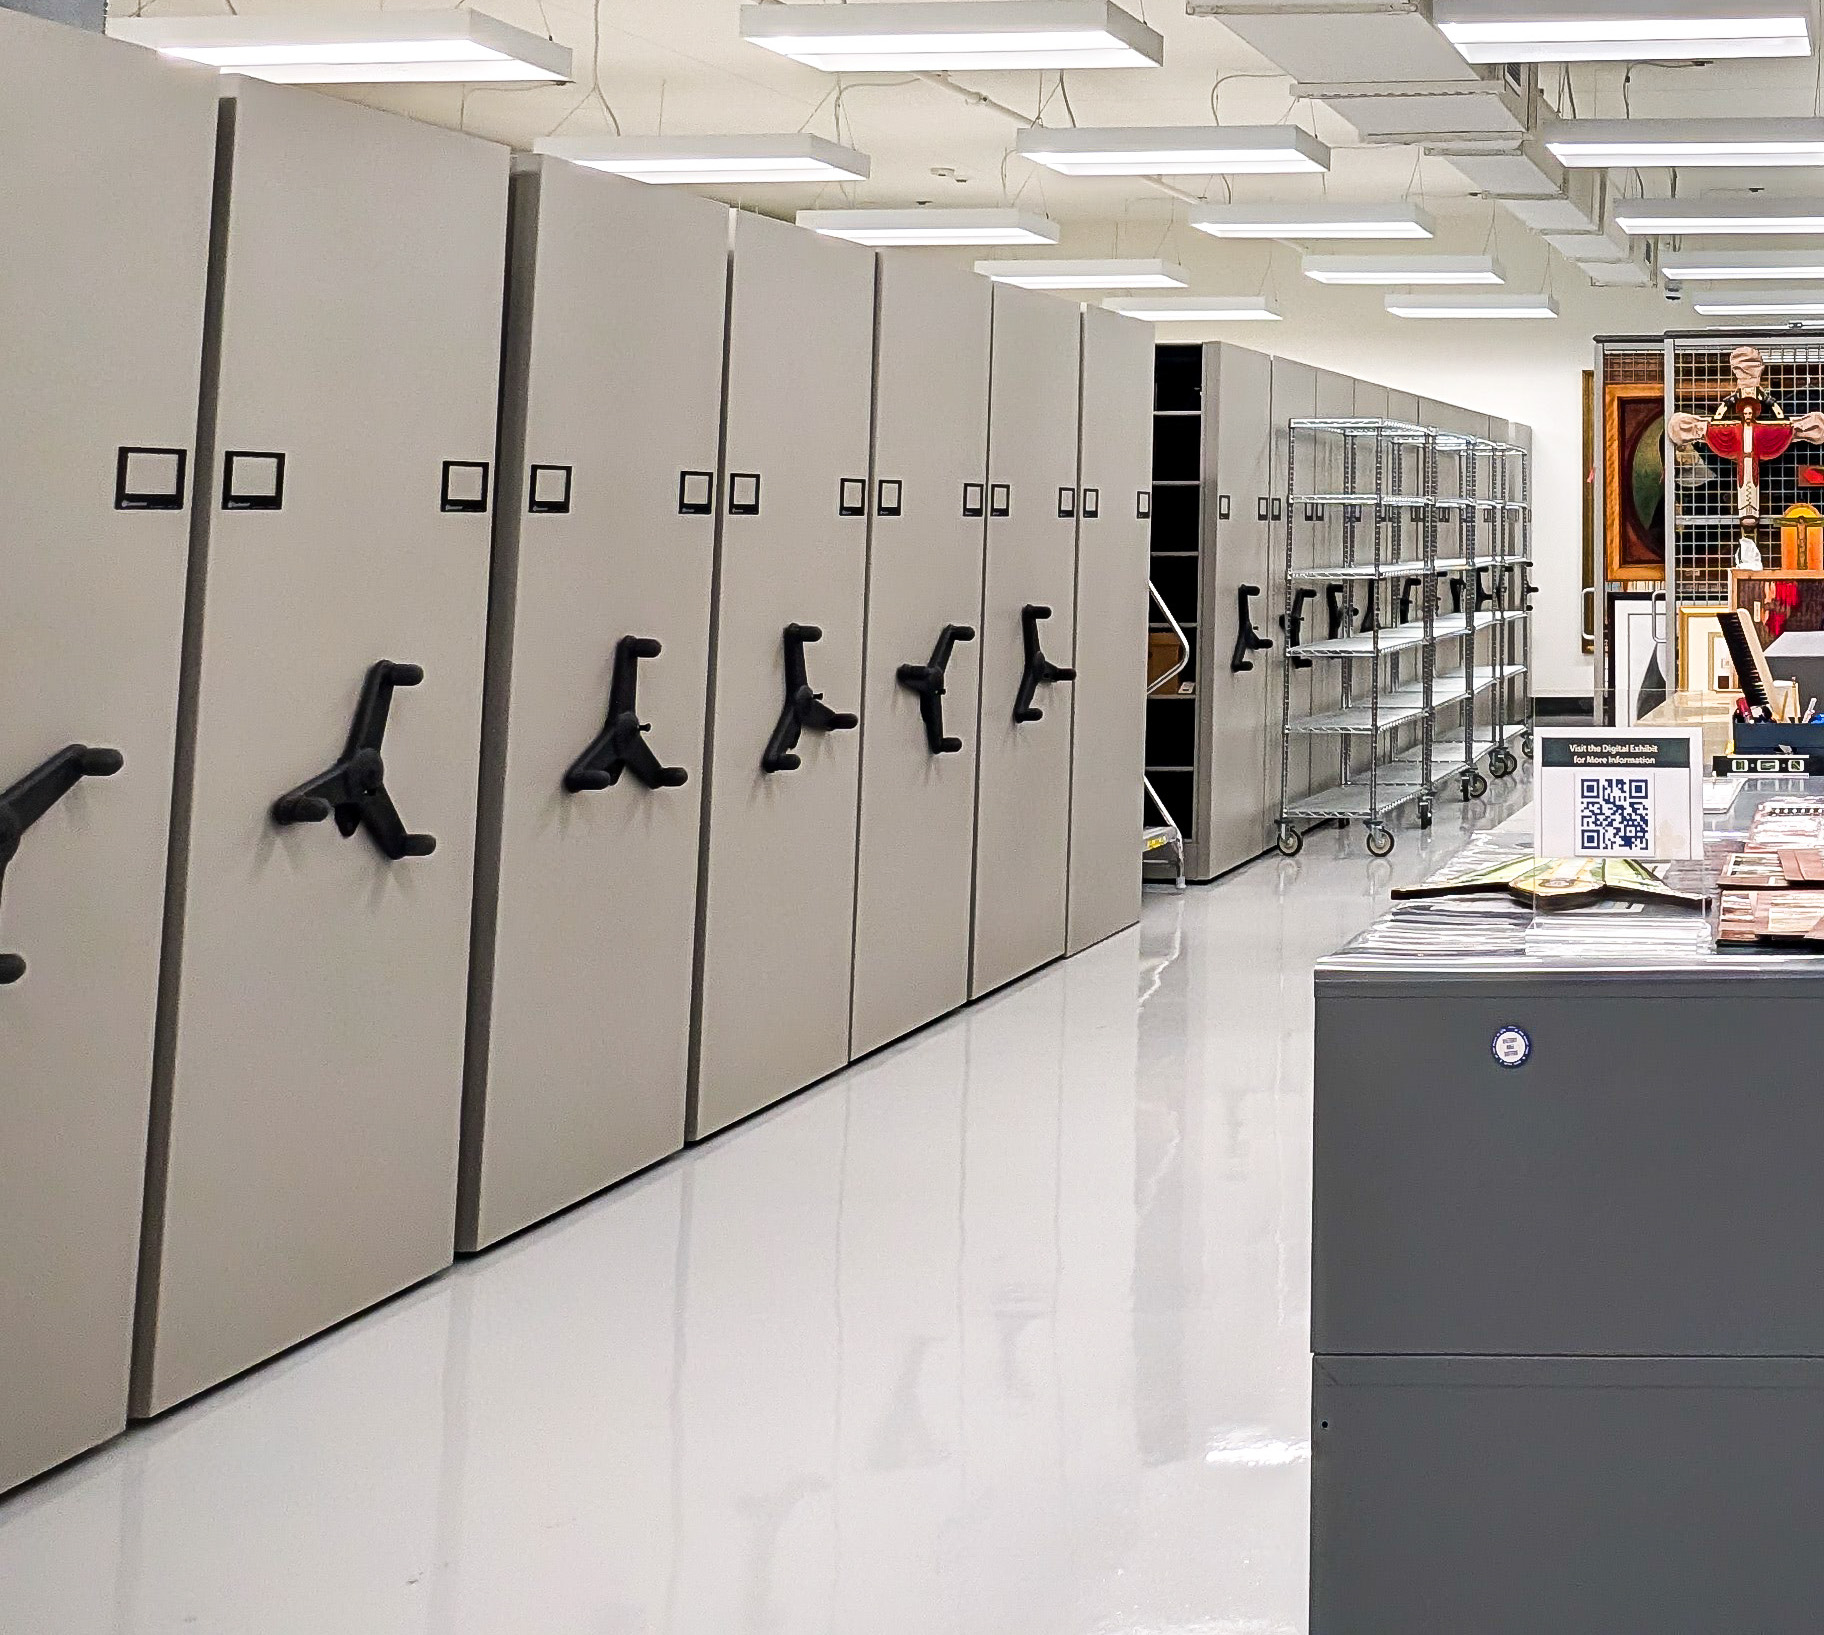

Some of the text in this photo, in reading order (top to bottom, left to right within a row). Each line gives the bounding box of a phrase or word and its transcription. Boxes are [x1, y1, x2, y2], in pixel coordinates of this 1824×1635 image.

[1569, 744, 1659, 755] Visit the Digital Exhibit
[1573, 755, 1656, 764] for More Information
